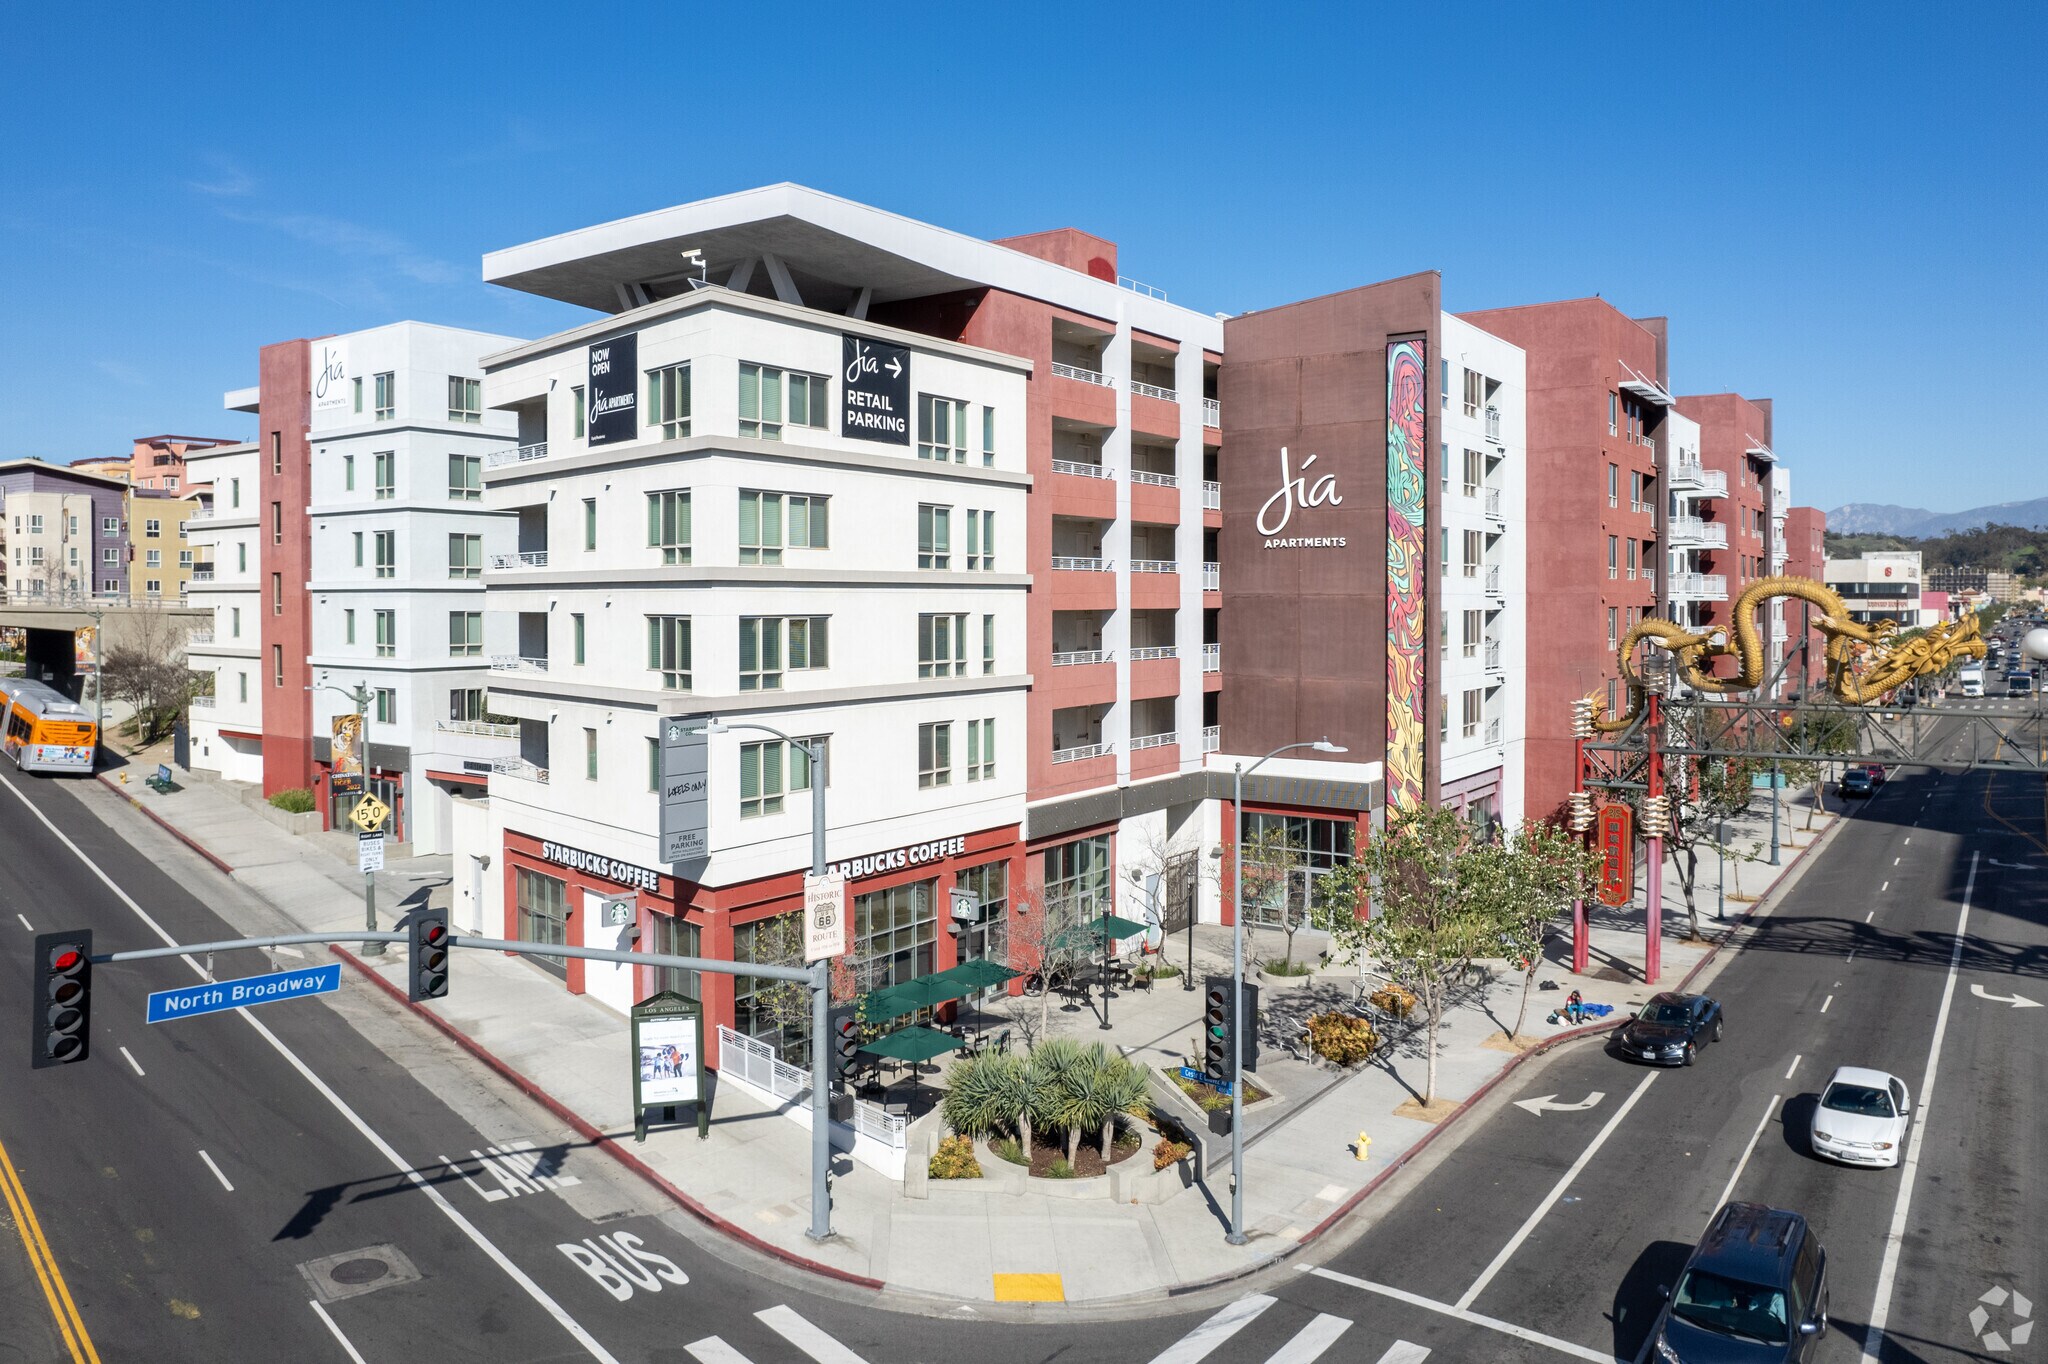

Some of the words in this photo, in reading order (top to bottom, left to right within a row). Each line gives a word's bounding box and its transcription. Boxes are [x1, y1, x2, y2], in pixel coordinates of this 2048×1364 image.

[592, 348, 610, 363] NOW
[592, 361, 610, 376] OPEN
[609, 393, 634, 408] APARTMENTS
[847, 389, 893, 411] RETAIL
[847, 410, 905, 433] PARKING
[1264, 537, 1347, 549] APARTMENTS
[671, 839, 703, 850] PARKING
[679, 834, 695, 842] FREE
[805, 850, 906, 880] ARBUCKS
[909, 836, 965, 864] COFFEE
[542, 841, 609, 876] STARBUCKS
[610, 860, 658, 891] COFFEE
[808, 890, 842, 903] HISTORIC
[818, 916, 831, 926] 66
[812, 930, 837, 942] ROUTE
[165, 990, 222, 1012] North
[232, 974, 326, 1001] Broadway
[660, 1004, 689, 1012] ANGELES
[438, 1140, 582, 1202] LANE
[556, 1231, 690, 1302] BUS
